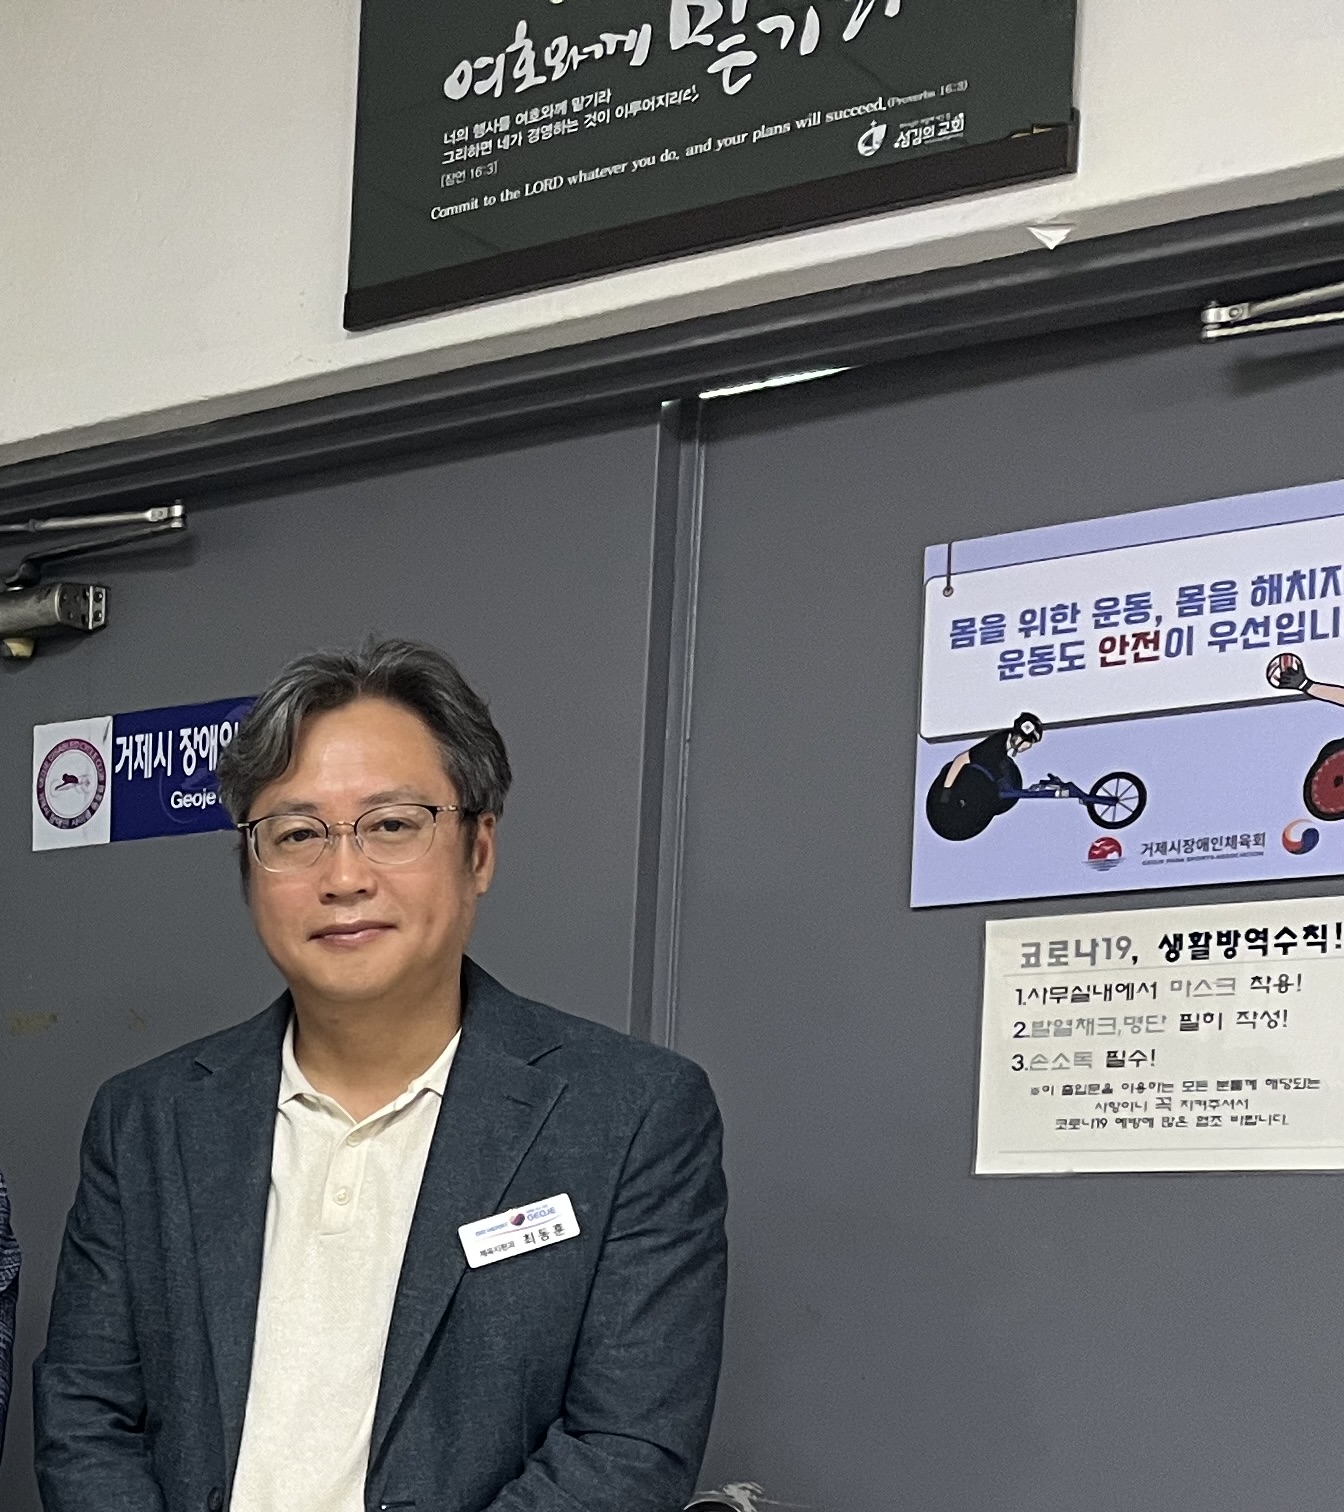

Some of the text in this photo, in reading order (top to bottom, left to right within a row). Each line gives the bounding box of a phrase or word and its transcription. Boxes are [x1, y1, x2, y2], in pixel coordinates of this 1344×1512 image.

[443, 20, 652, 101] 여호와께
[442, 139, 492, 165] 그리하면
[497, 131, 522, 151] 네가
[527, 117, 579, 145] 경영하는
[584, 108, 611, 129] 것이
[443, 126, 469, 146] 너의
[430, 198, 480, 221] Commit
[483, 194, 497, 208] to
[500, 188, 521, 203] the
[524, 175, 564, 197] LORD
[567, 161, 629, 186] whatever
[631, 153, 656, 173] you
[685, 137, 712, 157] and
[715, 131, 749, 152] your
[752, 121, 792, 144] plans
[795, 110, 822, 130] will
[825, 96, 887, 124] succeed.
[949, 613, 1007, 649] 몸을
[1018, 602, 1081, 638] 위한
[1092, 591, 1163, 630] 운동,
[1176, 580, 1238, 618] 몸을
[997, 640, 1086, 681] 운동도
[1098, 625, 1194, 667] 안전이
[115, 730, 172, 780] 거제시
[170, 789, 216, 809] Geoje
[1141, 832, 1266, 857] 거제시장애인체육회
[1021, 922, 1343, 968] 코로나19, 생활방역수칙!
[1170, 977, 1236, 997] 마스크
[1250, 973, 1302, 994] 착용!
[1236, 1009, 1288, 1029] 작성!
[1106, 1049, 1156, 1068] 필수!
[1155, 1096, 1172, 1112] 꼭
